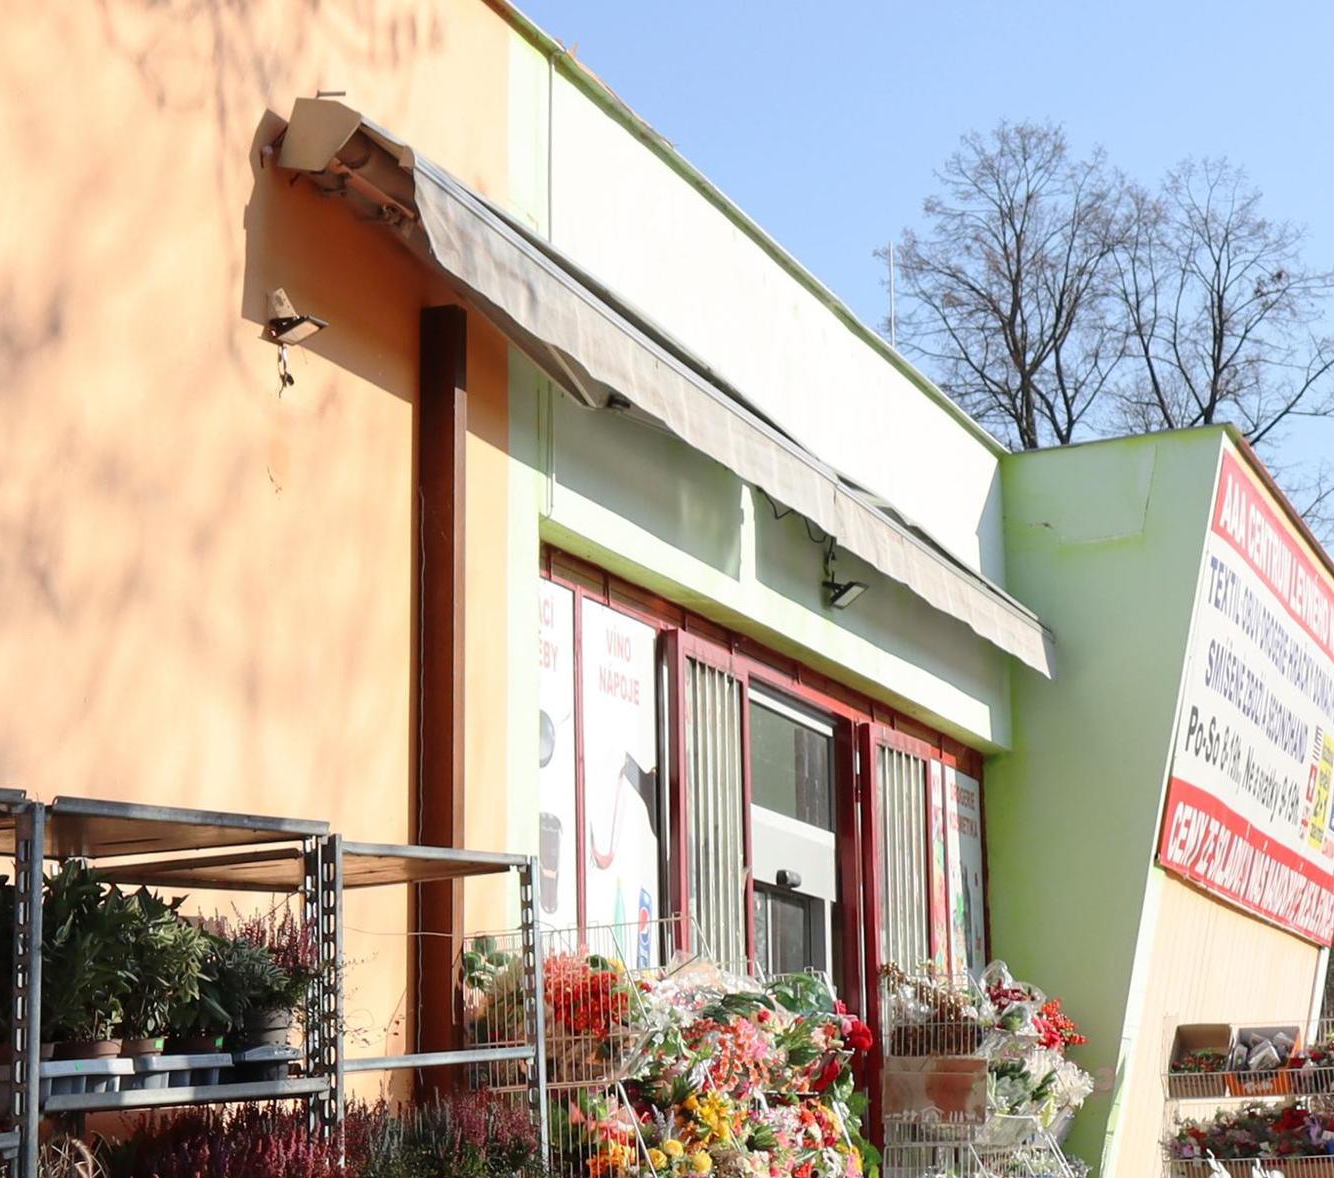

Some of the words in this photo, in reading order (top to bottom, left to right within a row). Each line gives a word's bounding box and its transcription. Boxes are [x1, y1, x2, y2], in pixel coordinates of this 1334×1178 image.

[1220, 474, 1247, 547] AAA
[1248, 503, 1292, 602] CENTRUM
[606, 626, 632, 662] VÍNO
[599, 665, 640, 705] NÁPOJE
[1185, 705, 1220, 766] Po-So
[1167, 801, 1209, 865] CENY
